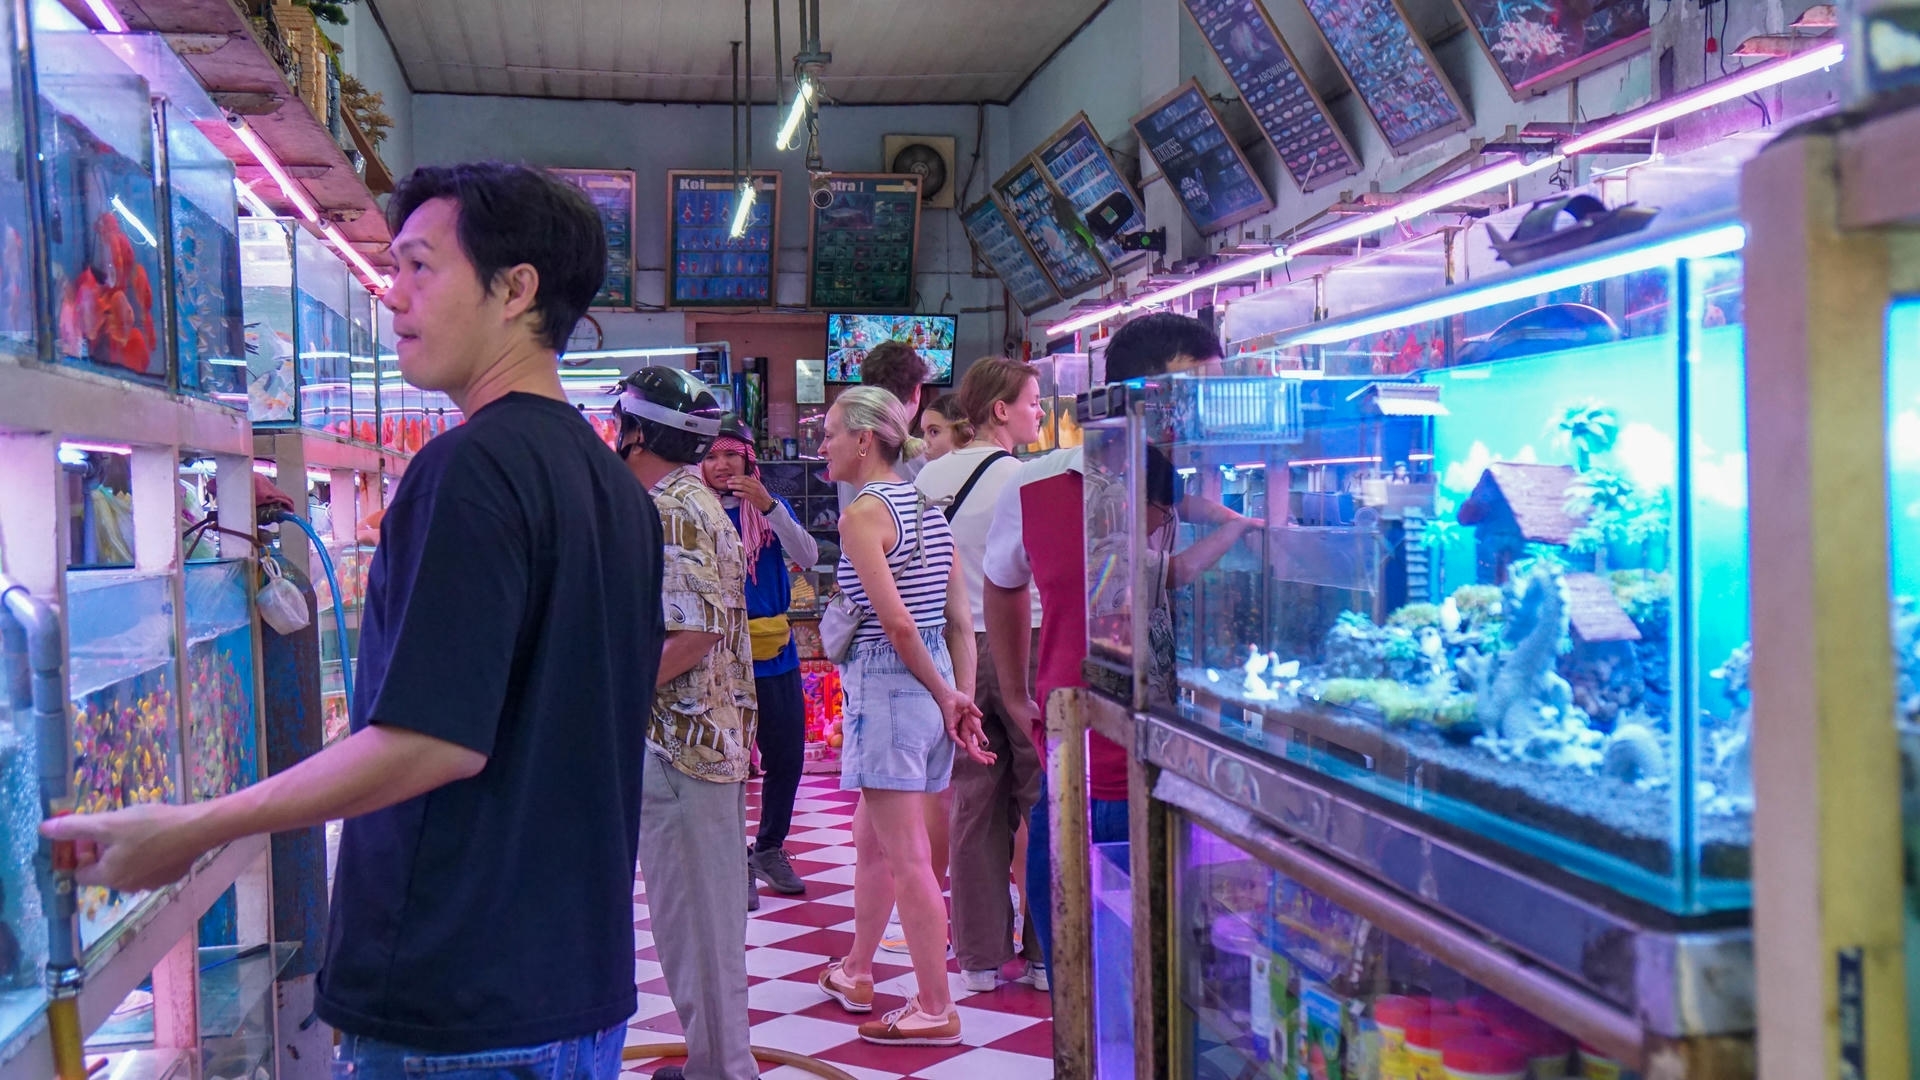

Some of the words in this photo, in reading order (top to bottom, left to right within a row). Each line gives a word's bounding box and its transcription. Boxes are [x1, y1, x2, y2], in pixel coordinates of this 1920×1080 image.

[1258, 58, 1291, 84] AROWANA
[679, 178, 705, 190] Koi
[830, 180, 856, 192] etra
